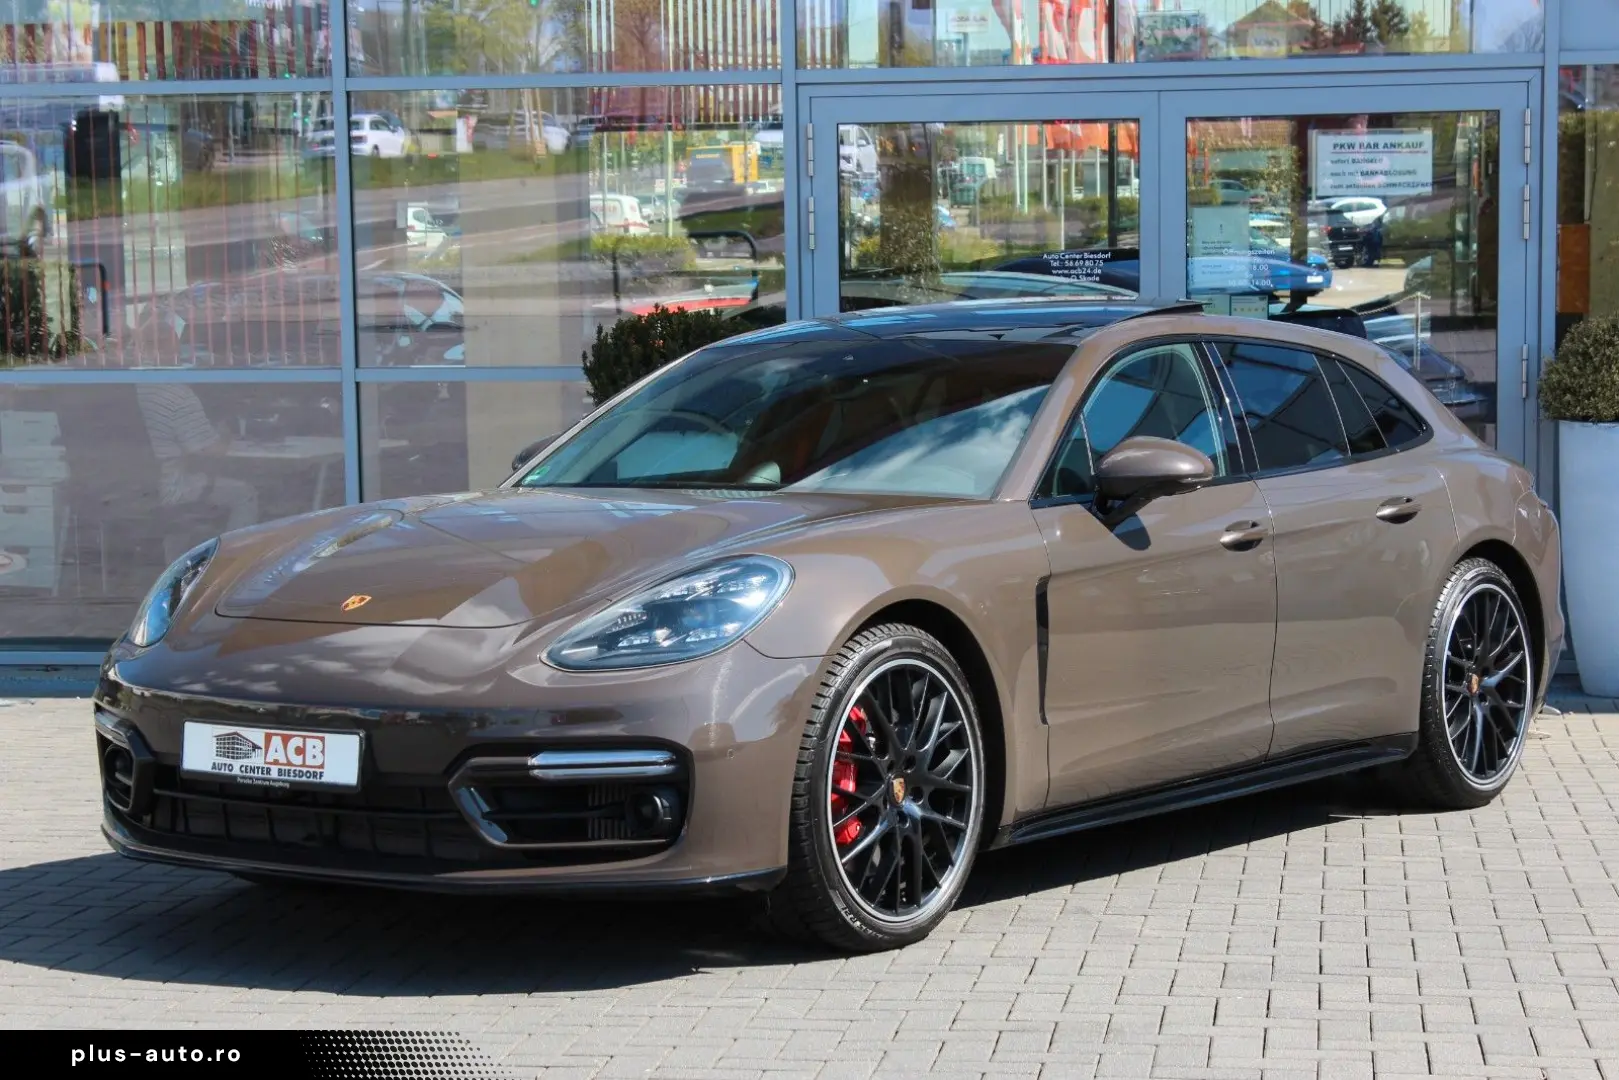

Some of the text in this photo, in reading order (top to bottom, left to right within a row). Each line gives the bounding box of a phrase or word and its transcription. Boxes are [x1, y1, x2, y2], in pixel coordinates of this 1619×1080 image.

[1332, 140, 1426, 150] PKW BAR ANKAUF
[1060, 252, 1083, 260] Center
[1083, 251, 1112, 259] Biesdorf
[265, 734, 325, 767] ACB
[211, 761, 325, 780] AUTO CENTER BIESDORF
